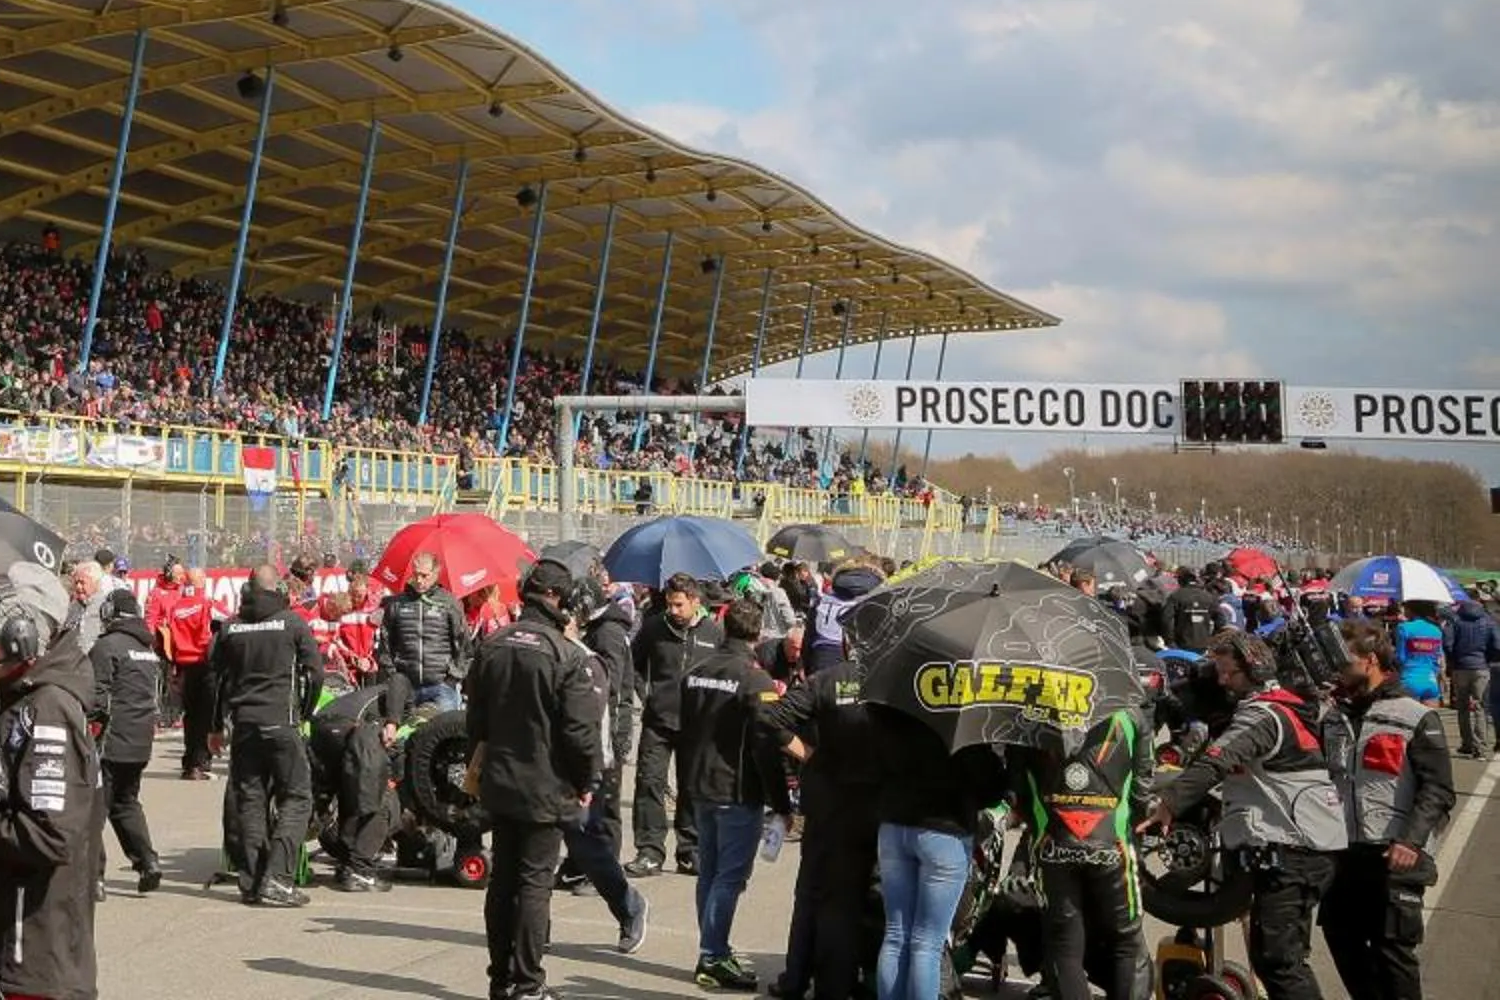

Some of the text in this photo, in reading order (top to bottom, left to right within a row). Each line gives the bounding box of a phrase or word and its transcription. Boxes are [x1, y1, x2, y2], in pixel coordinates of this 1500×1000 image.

[896, 386, 1174, 429] PROSECCO DOC
[919, 663, 1094, 714] GALFER
